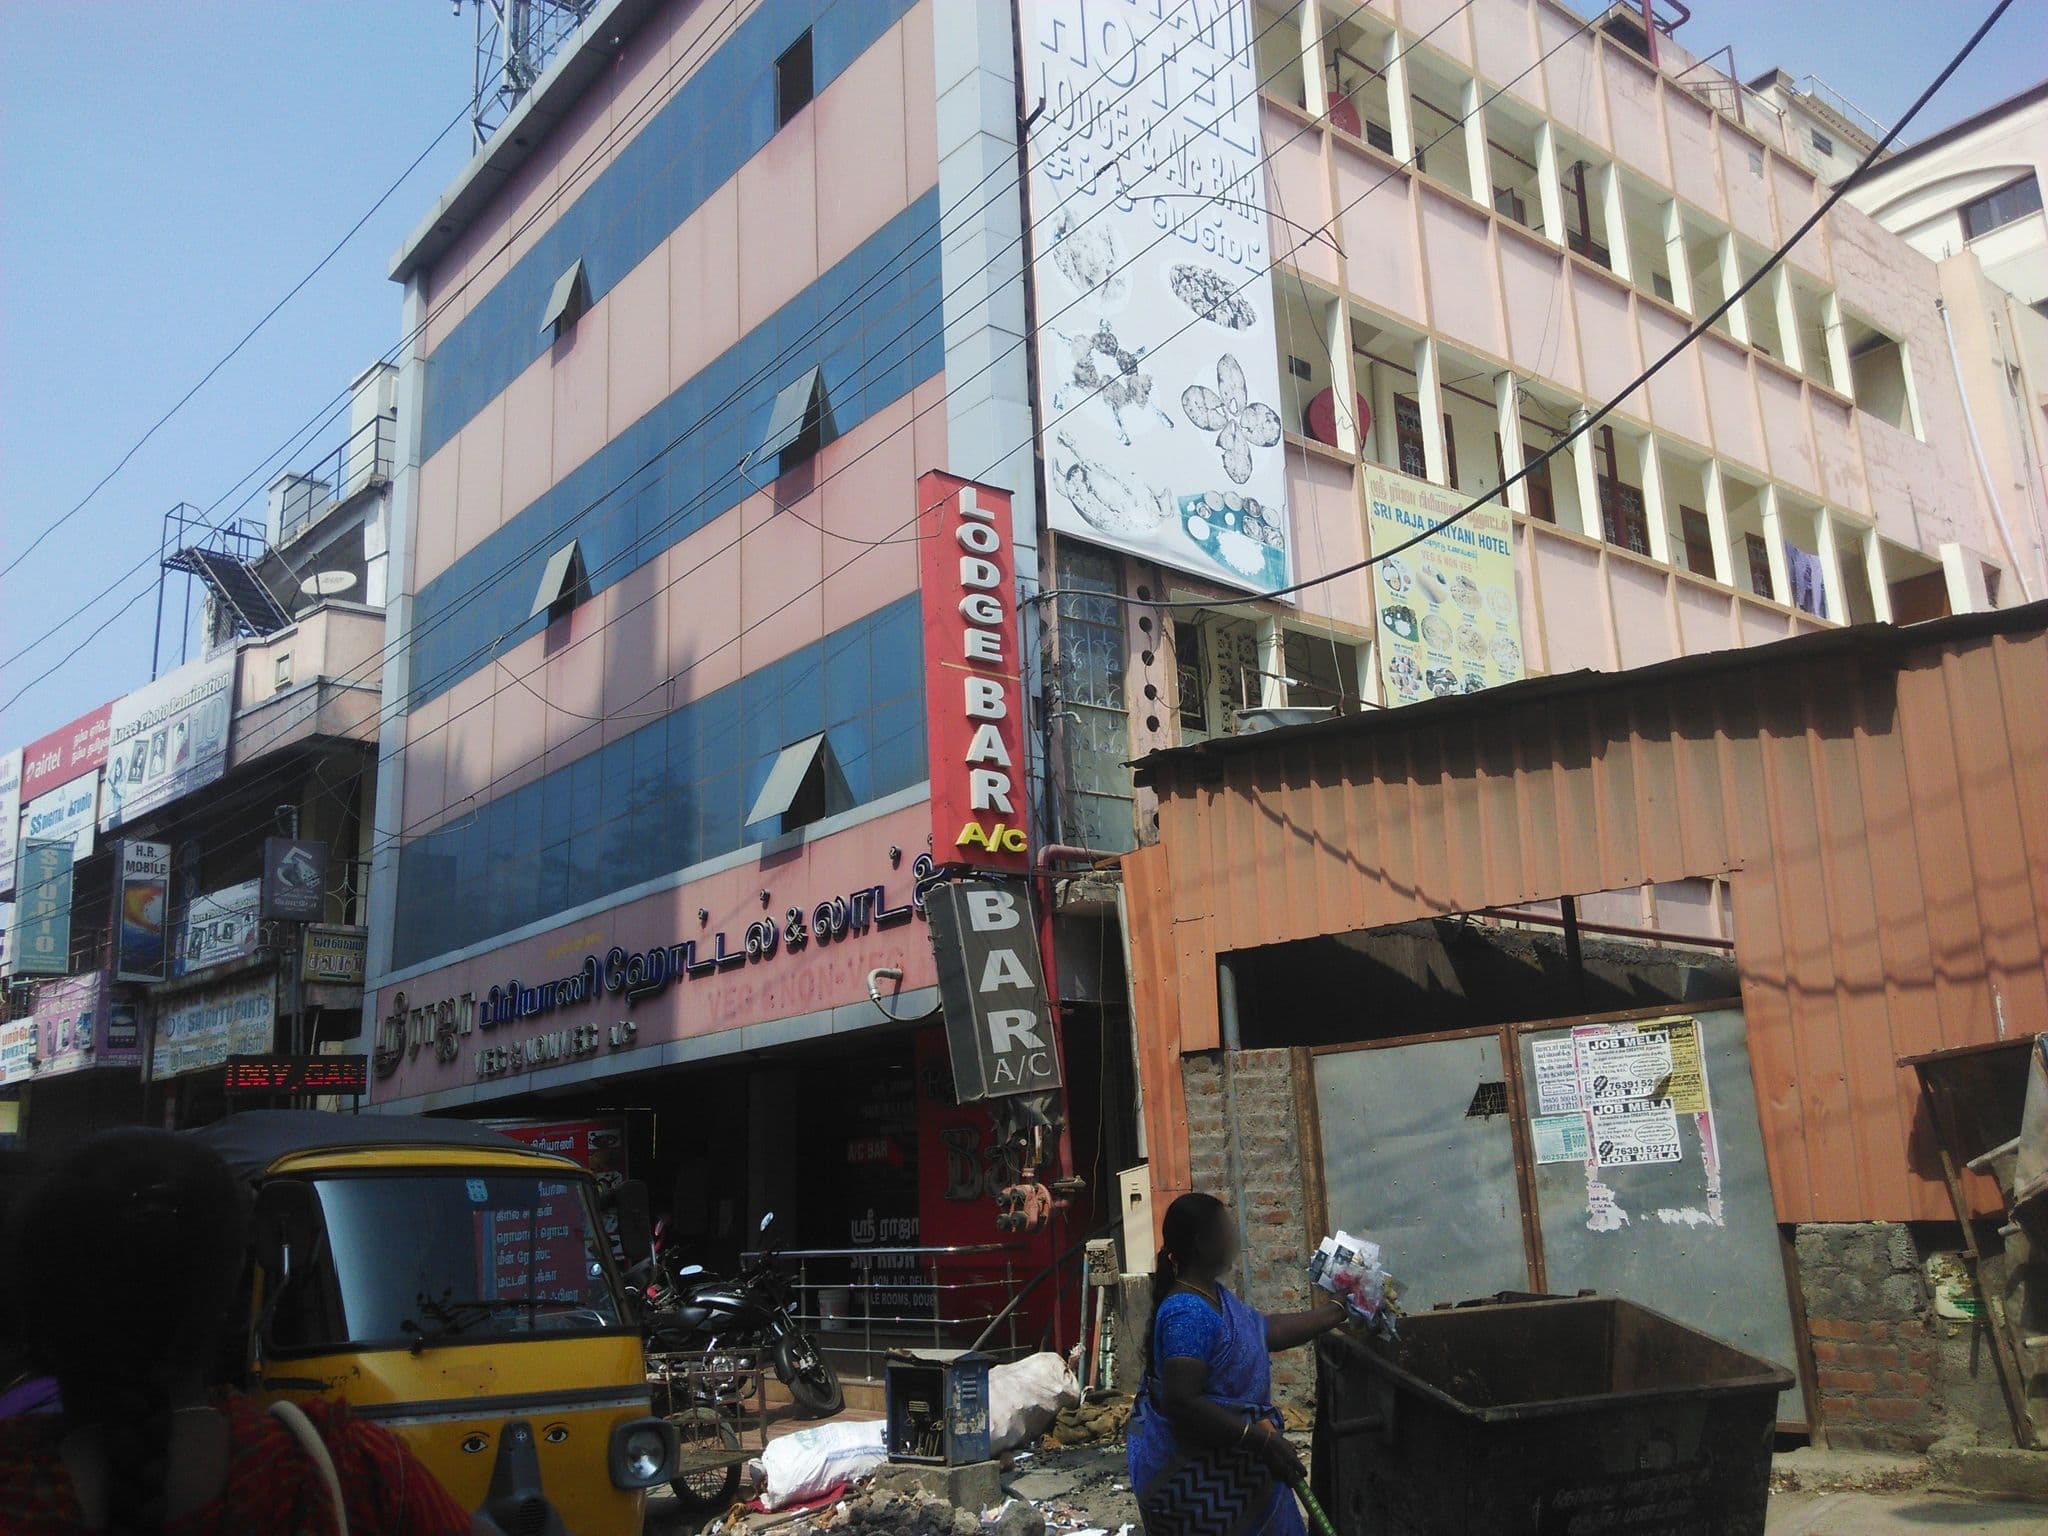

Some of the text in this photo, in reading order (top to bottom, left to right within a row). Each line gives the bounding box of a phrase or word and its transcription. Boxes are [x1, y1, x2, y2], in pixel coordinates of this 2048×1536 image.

[1038, 63, 1130, 166] LODGE
[1373, 501, 1392, 521] SRI
[1395, 507, 1425, 532] RAJA
[1427, 517, 1476, 546] BRIYANI
[1478, 534, 1511, 557] HOTEL
[955, 486, 1004, 663] LODGE
[964, 676, 1015, 815] BAR
[35, 747, 62, 779] airtel
[135, 844, 158, 858] H.R.
[955, 822, 1028, 854] A/C
[125, 860, 167, 875] MOBILE
[602, 894, 780, 1010] ஹோட்டல்
[782, 905, 809, 949] &
[966, 890, 1047, 1054] BAR
[1590, 1034, 1665, 1050] JOB MELA
[993, 1052, 1052, 1086] A/C
[1608, 1081, 1639, 1090] 76391
[1595, 1099, 1669, 1115] JOB MELA
[1602, 1152, 1678, 1165] JOB MELA
[1614, 1143, 1678, 1155] 76391 52777
[851, 1208, 920, 1242] ஸ்ரீ ராஜா
